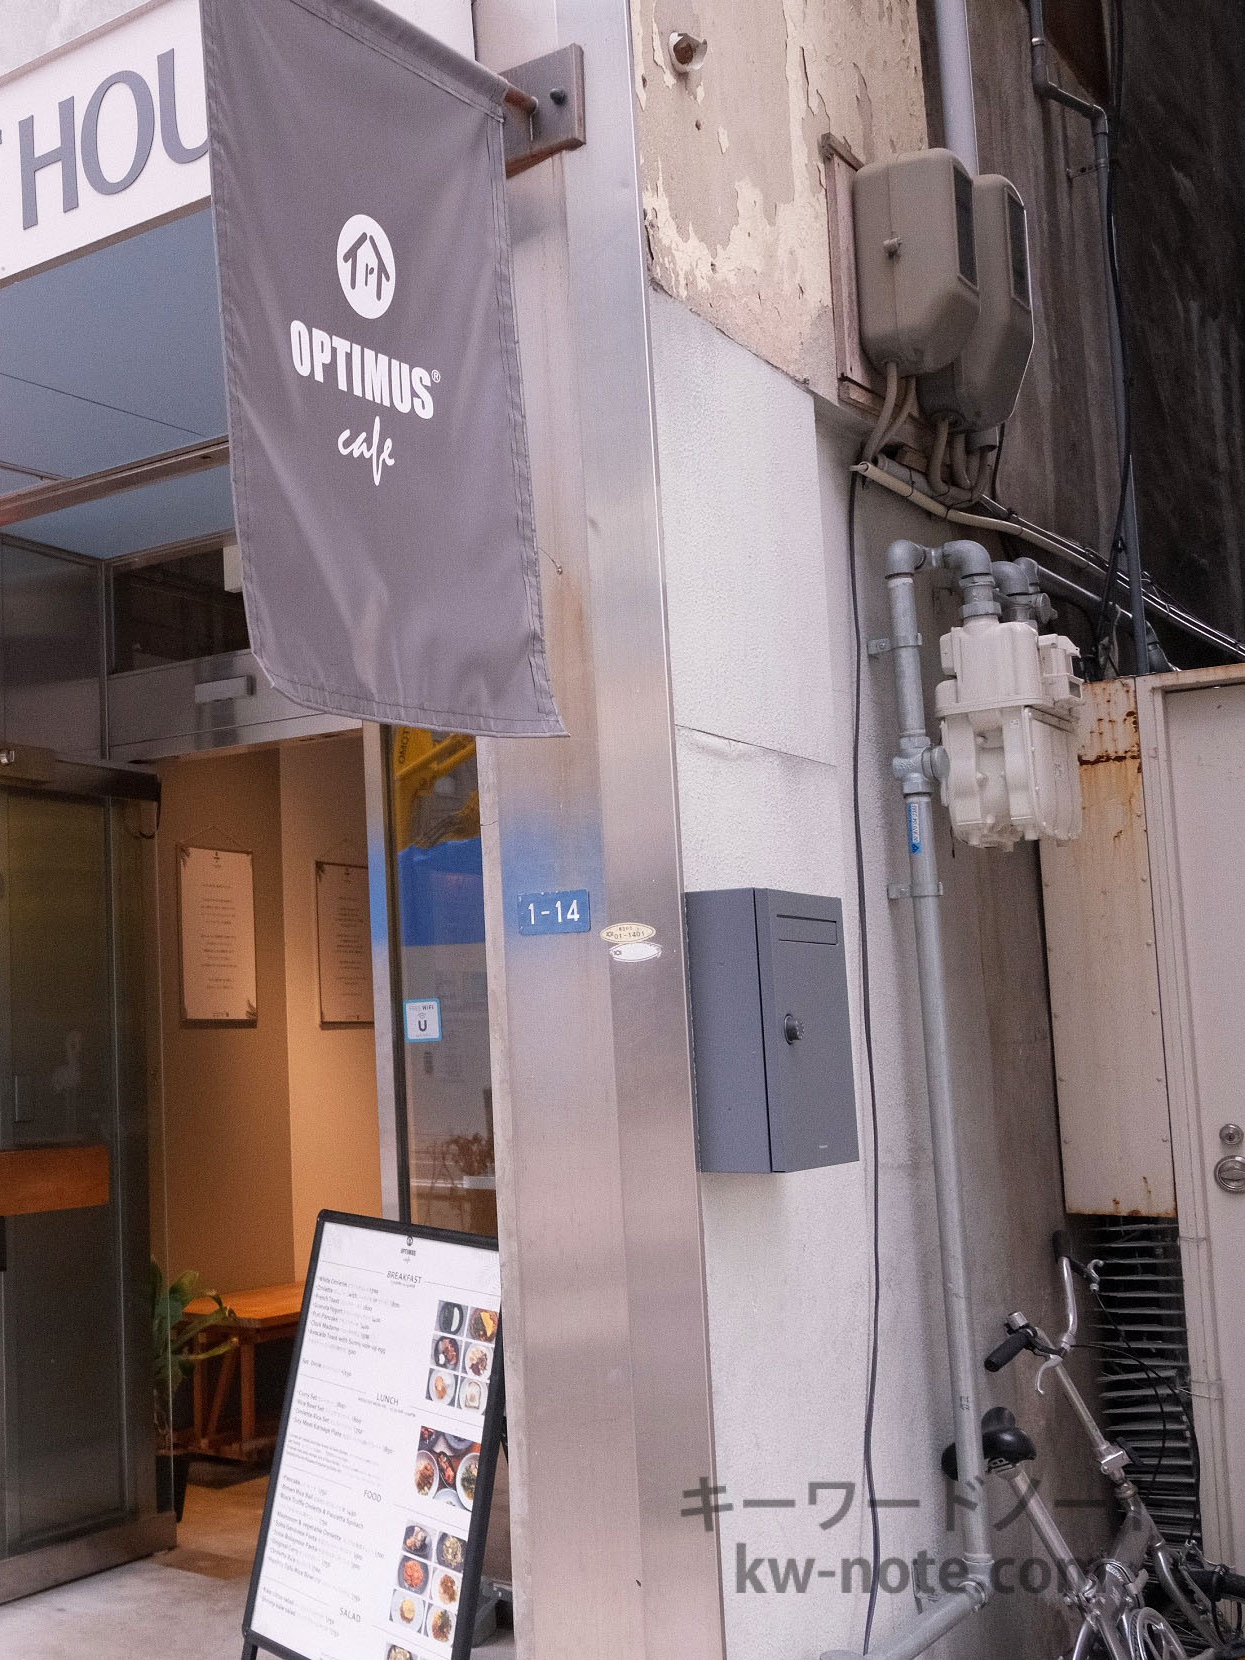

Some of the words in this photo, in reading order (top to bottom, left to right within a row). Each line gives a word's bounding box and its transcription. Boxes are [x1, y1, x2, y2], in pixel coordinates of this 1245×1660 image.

[337, 416, 396, 486] cafe
[528, 900, 580, 925] 1-14
[386, 1270, 422, 1284] BREAKFAST
[376, 1393, 399, 1406] LUNCH
[363, 1489, 382, 1503] FOOD
[340, 1607, 361, 1623] SALAD
